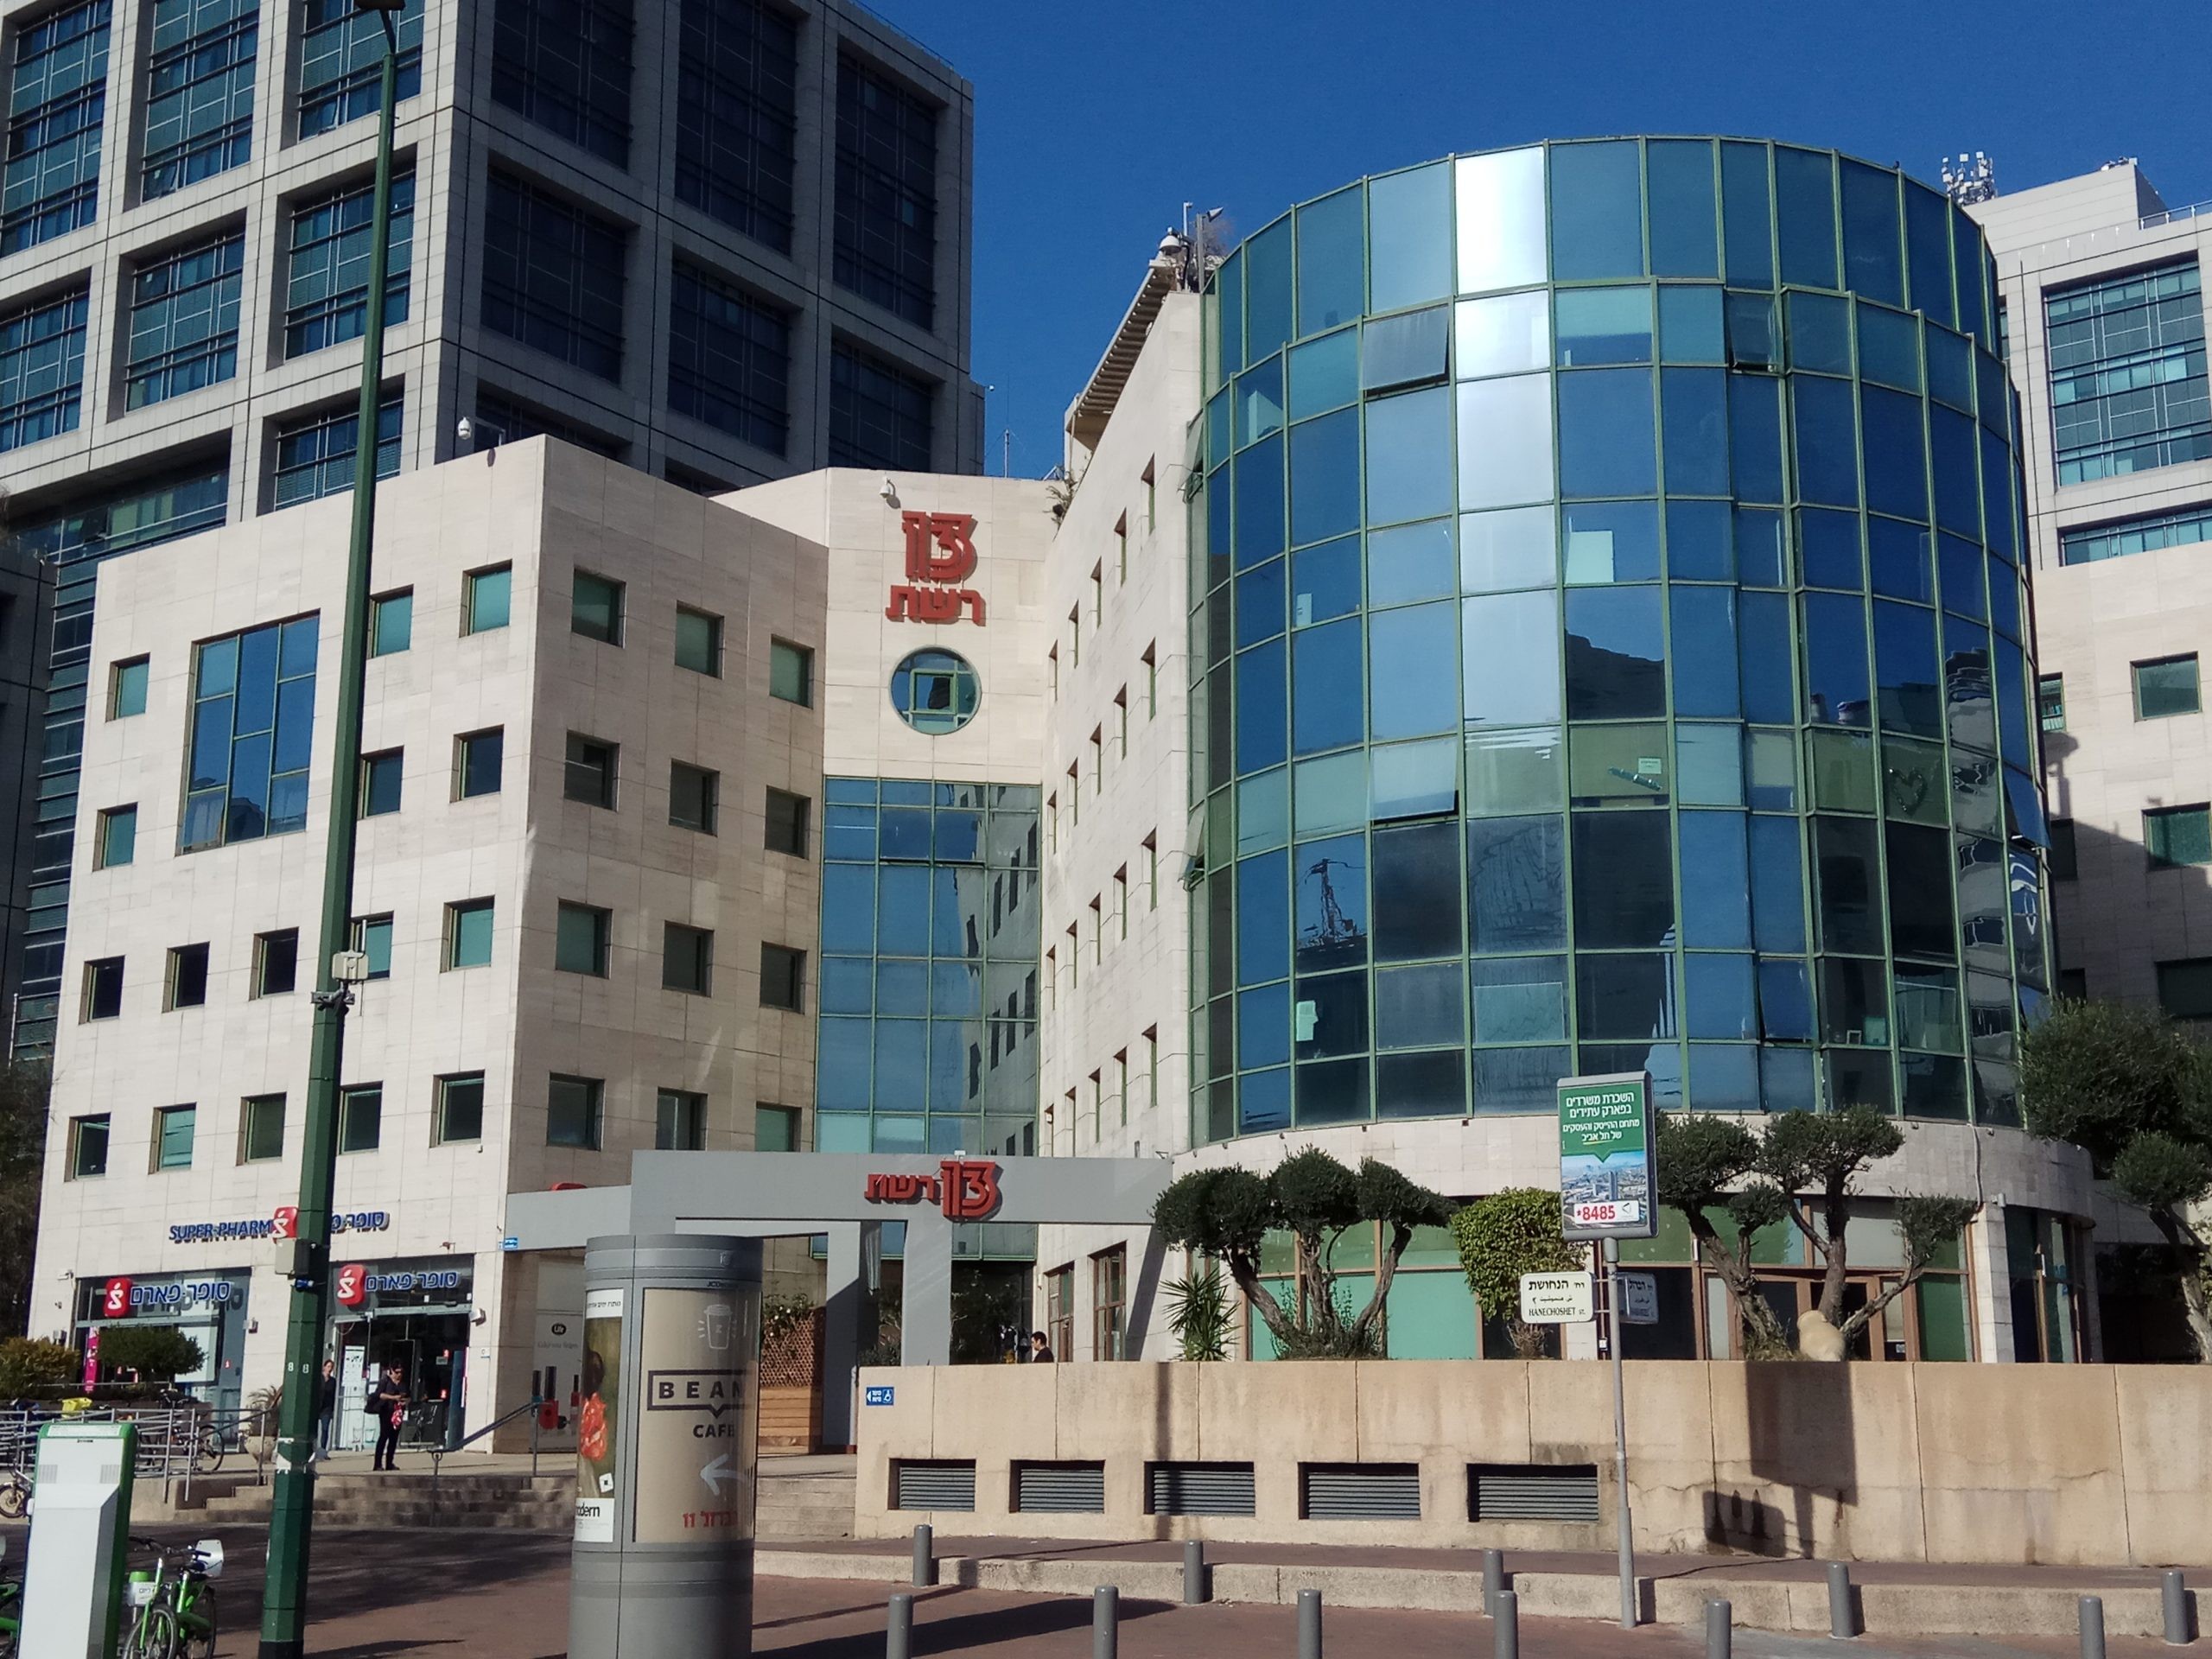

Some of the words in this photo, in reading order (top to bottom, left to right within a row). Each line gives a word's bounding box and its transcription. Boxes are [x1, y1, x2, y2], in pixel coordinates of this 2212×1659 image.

[902, 510, 976, 583] 13
[886, 585, 985, 626] רשת
[1566, 1095, 1601, 1107] משרדים
[1602, 1092, 1634, 1104] השכרת
[1569, 1107, 1600, 1118] עתידים
[1601, 1104, 1632, 1117] בפארק
[1618, 1119, 1640, 1128] מתחם
[1599, 1131, 1610, 1141] תל
[1610, 1131, 1622, 1140] של
[864, 1173, 938, 1201] רשת
[1528, 1279, 1569, 1291] הנחושת
[1529, 1306, 1576, 1317] HANECHOSHET
[575, 1502, 601, 1518] odern
